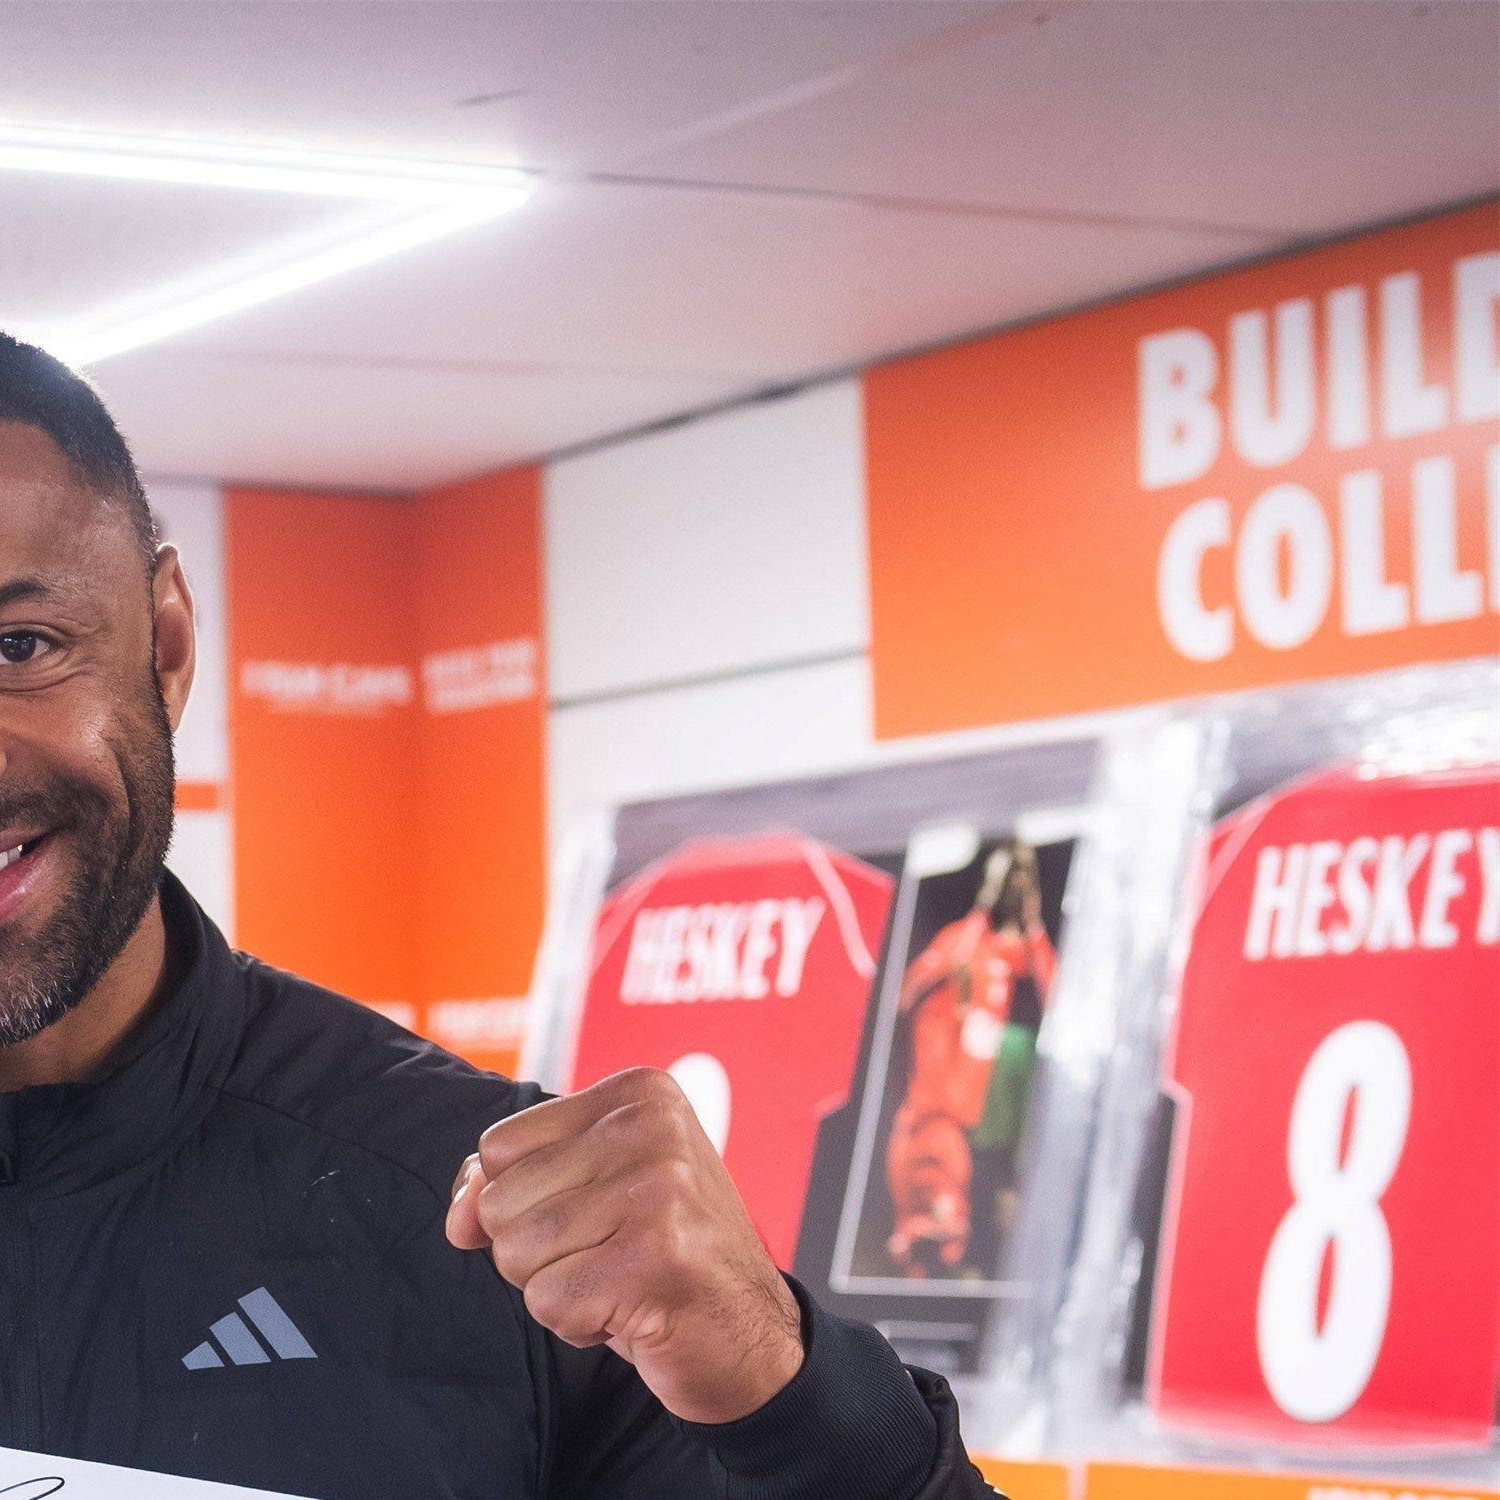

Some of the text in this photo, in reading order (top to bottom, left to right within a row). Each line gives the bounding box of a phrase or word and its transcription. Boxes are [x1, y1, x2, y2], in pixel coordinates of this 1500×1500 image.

[1156, 443, 1500, 662] COLL
[619, 896, 826, 1005] HESKEY
[1256, 1019, 1412, 1424] 8
